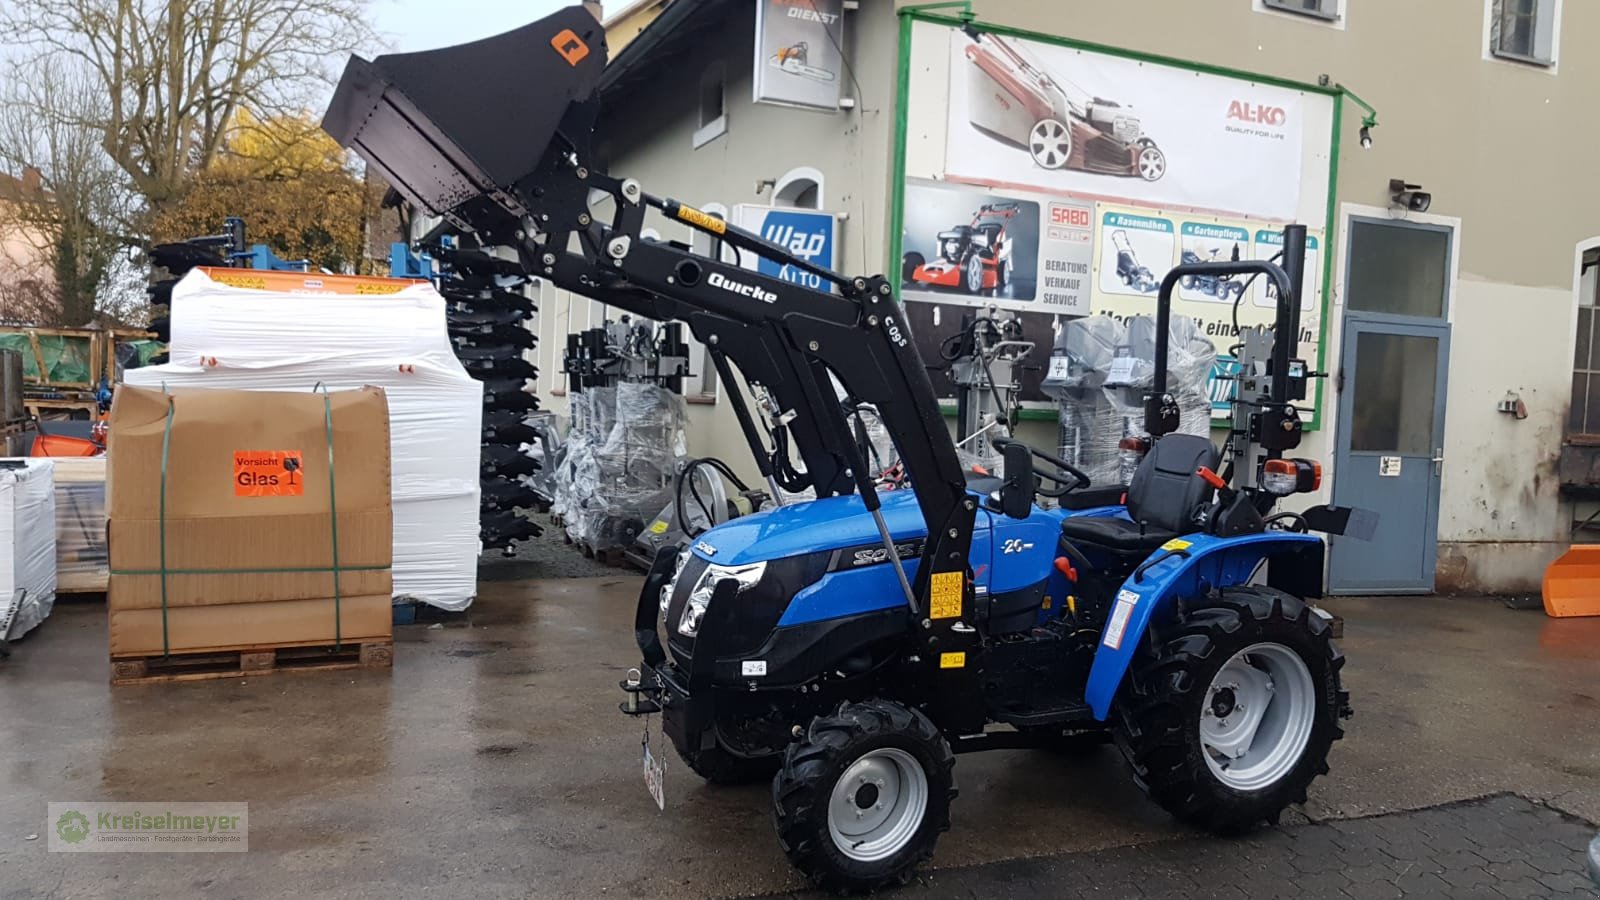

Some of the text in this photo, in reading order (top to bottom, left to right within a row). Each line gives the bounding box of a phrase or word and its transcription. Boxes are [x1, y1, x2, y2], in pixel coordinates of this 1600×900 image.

[786, 7, 839, 25] DIENST
[1225, 125, 1254, 136] QUALITY
[1270, 133, 1285, 141] LIFE
[1051, 207, 1089, 226] SABO
[1045, 259, 1088, 275] BERATUNG
[707, 272, 778, 304] Quicke
[1044, 276, 1081, 290] VERKAUF
[1043, 292, 1078, 306] SERVICE
[236, 458, 279, 466] Vorsicht
[237, 471, 279, 486] Glas
